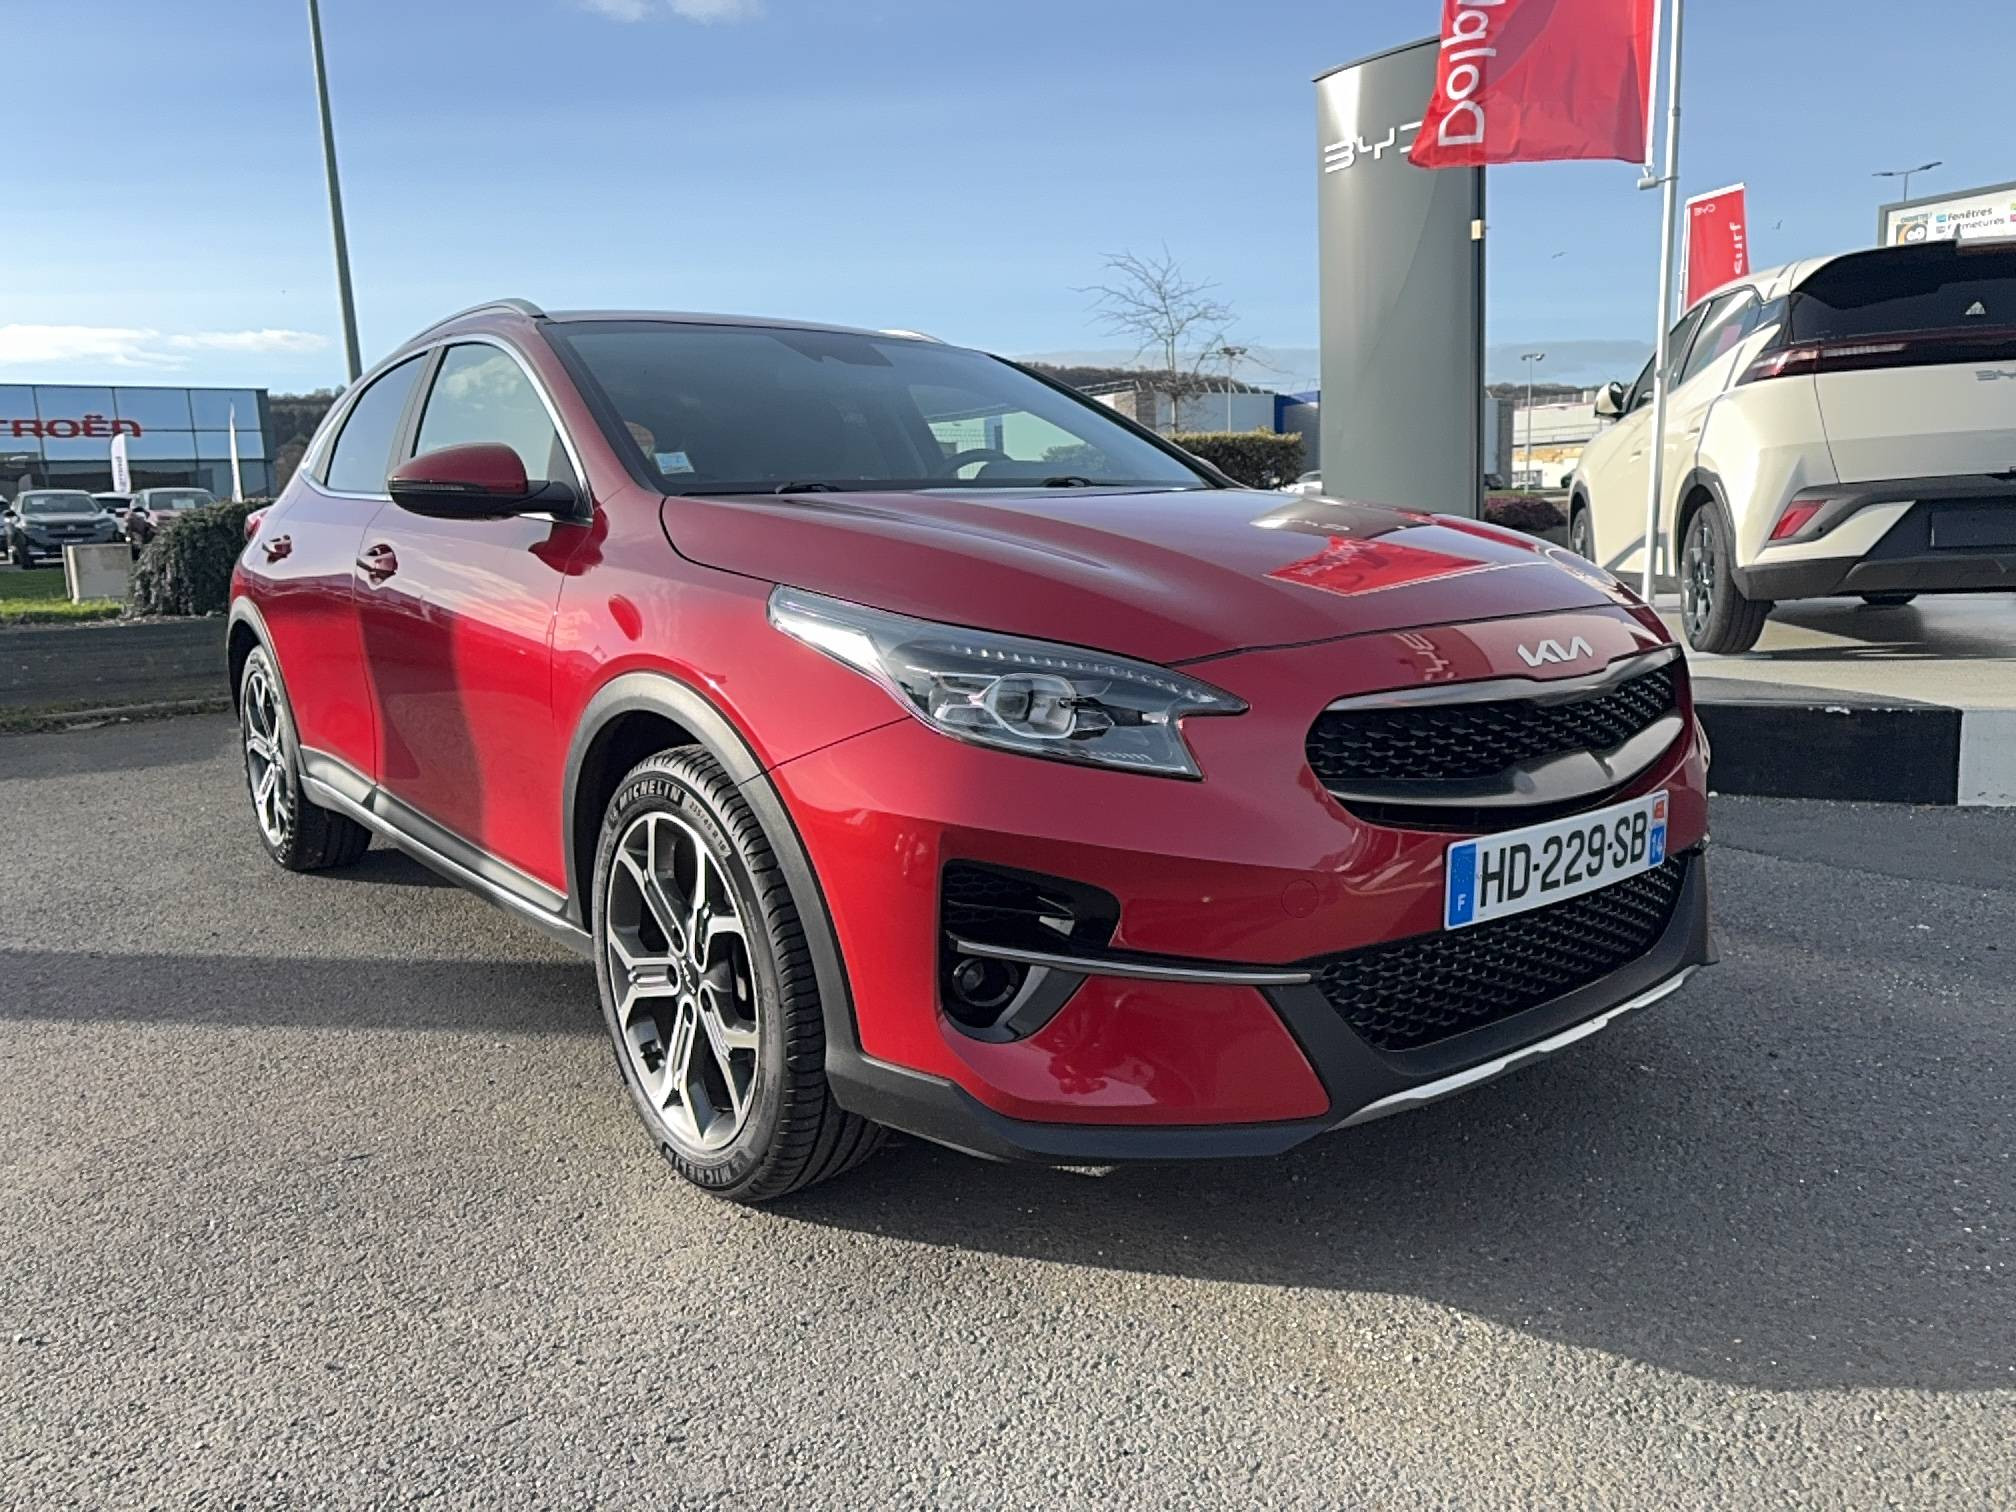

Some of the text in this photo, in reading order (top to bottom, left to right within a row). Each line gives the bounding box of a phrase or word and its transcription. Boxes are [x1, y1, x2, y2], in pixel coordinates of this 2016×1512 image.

[1517, 635, 1593, 667] KIA
[619, 780, 682, 811] MICHELIN
[1457, 893, 1467, 911] F
[1479, 810, 1649, 908] HD-229-SB
[664, 1146, 732, 1185] MICHELIN
